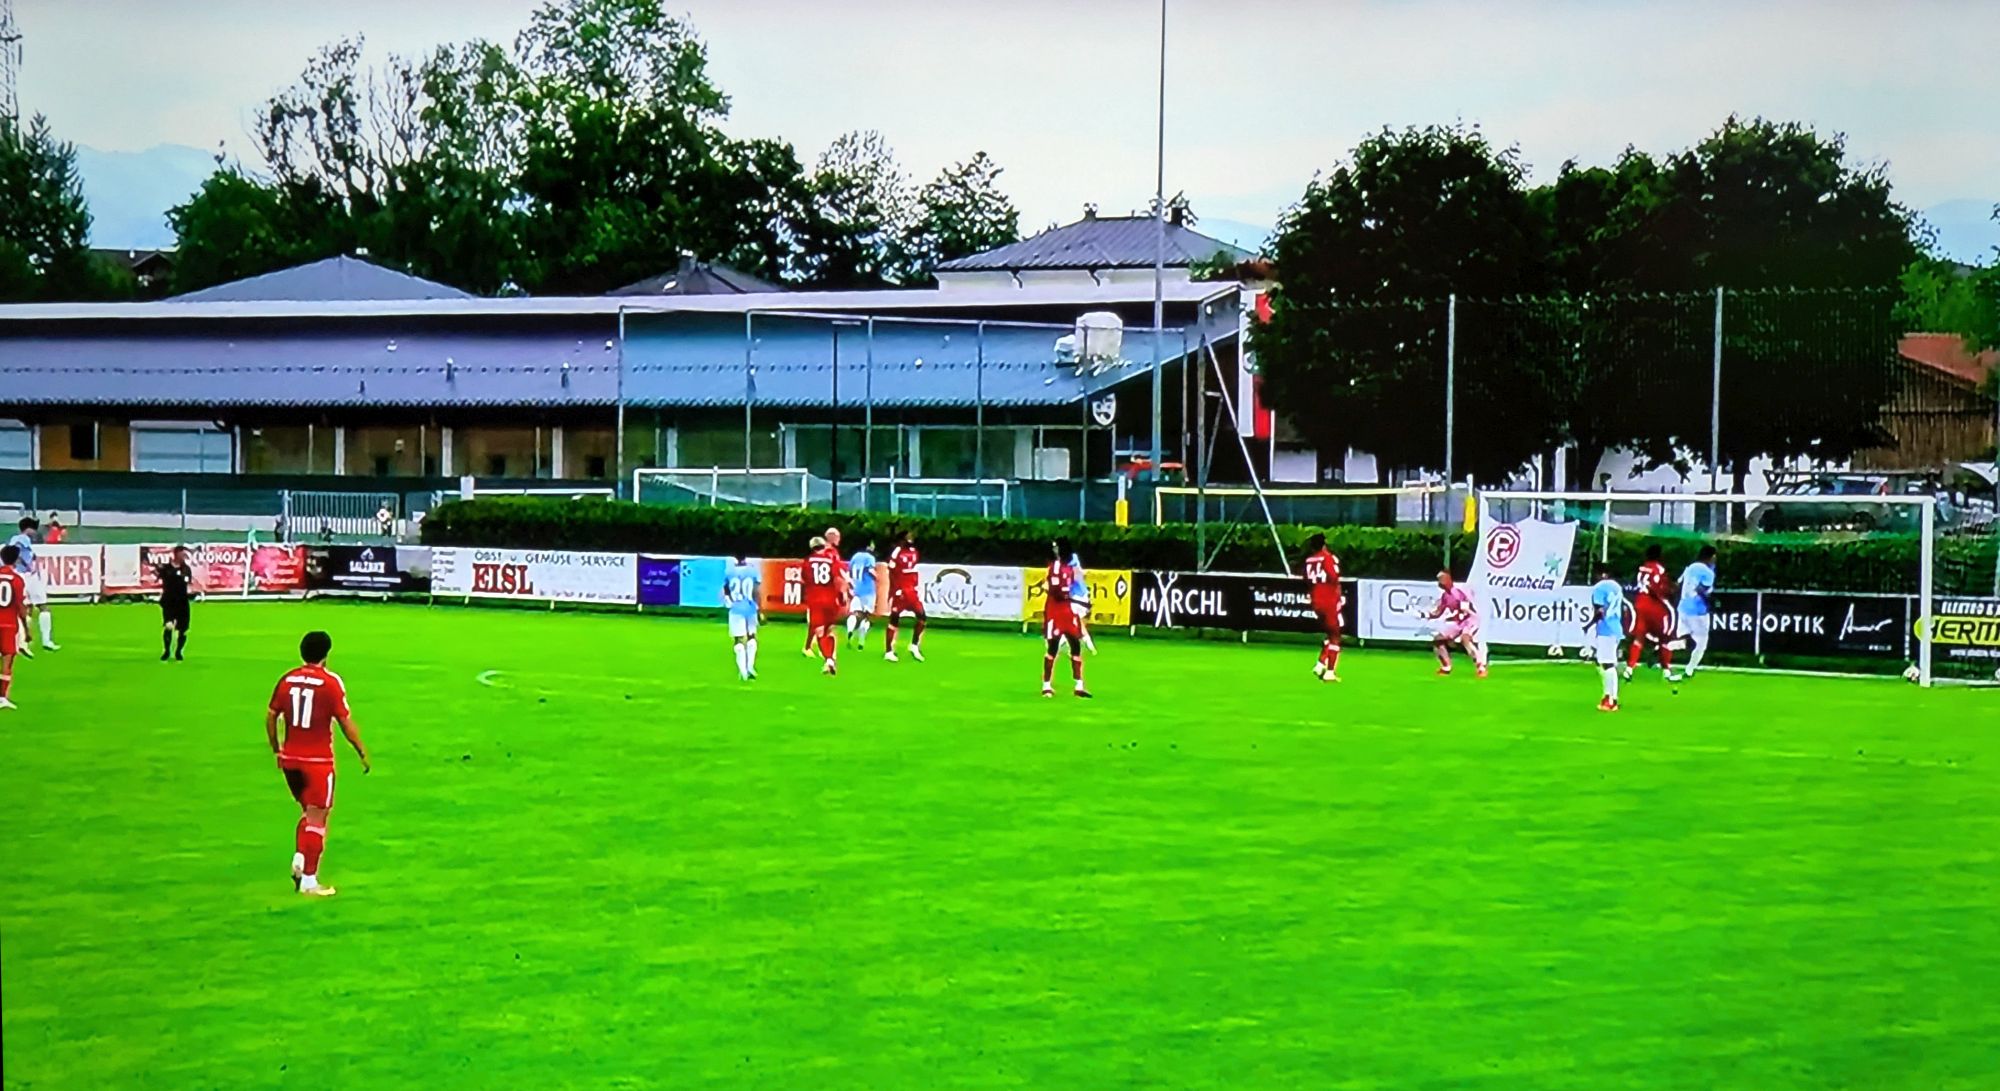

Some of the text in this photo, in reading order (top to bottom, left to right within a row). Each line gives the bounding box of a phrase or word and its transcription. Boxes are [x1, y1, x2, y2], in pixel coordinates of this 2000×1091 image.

[472, 563, 534, 594] EISL
[811, 562, 831, 585] 18
[1307, 563, 1327, 584] 44
[1763, 614, 1825, 635] OPTIK
[290, 687, 314, 728] 11
